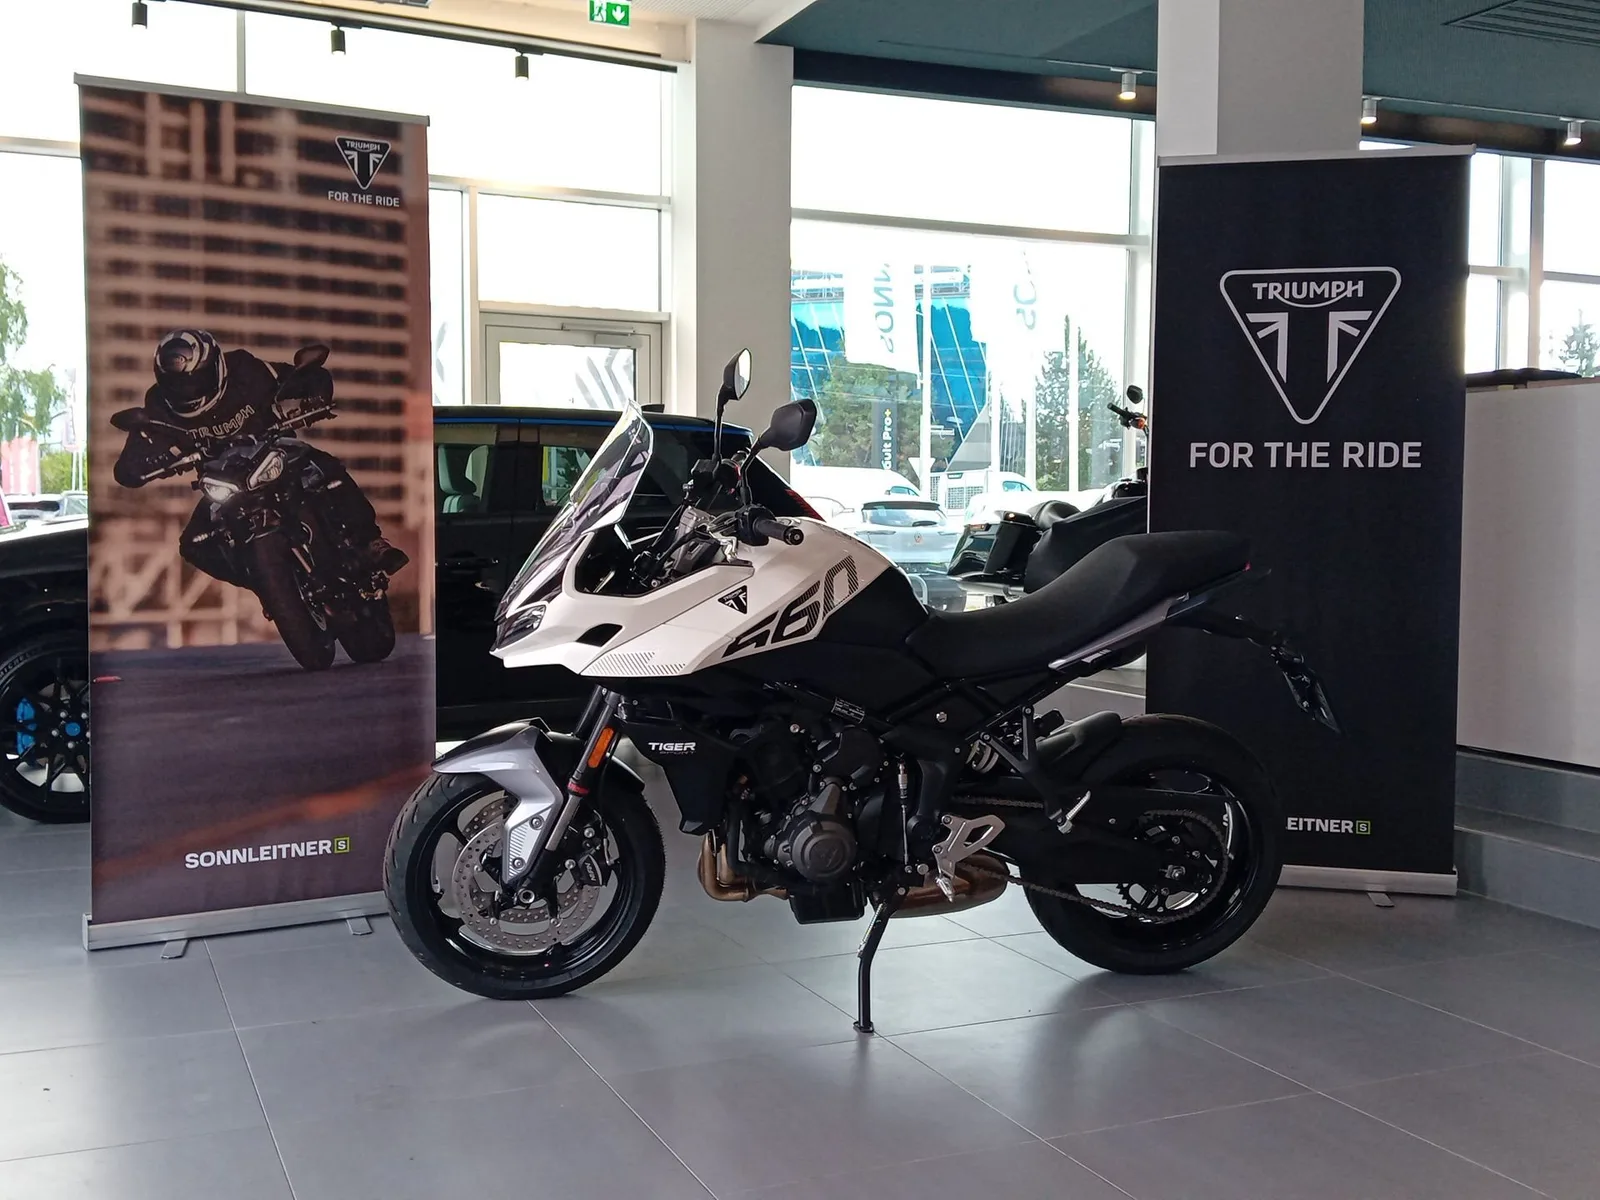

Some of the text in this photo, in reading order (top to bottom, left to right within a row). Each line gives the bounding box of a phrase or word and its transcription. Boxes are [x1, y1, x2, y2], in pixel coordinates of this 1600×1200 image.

[345, 141, 380, 152] TRIUMPH
[328, 191, 400, 207] FOR THE RIDE
[1252, 281, 1364, 307] TRIUMPH
[189, 405, 255, 439] TRUMPH
[1190, 442, 1422, 468] FOR THE RIDE
[648, 742, 696, 751] TIGER
[185, 839, 332, 869] SONNLEITNER
